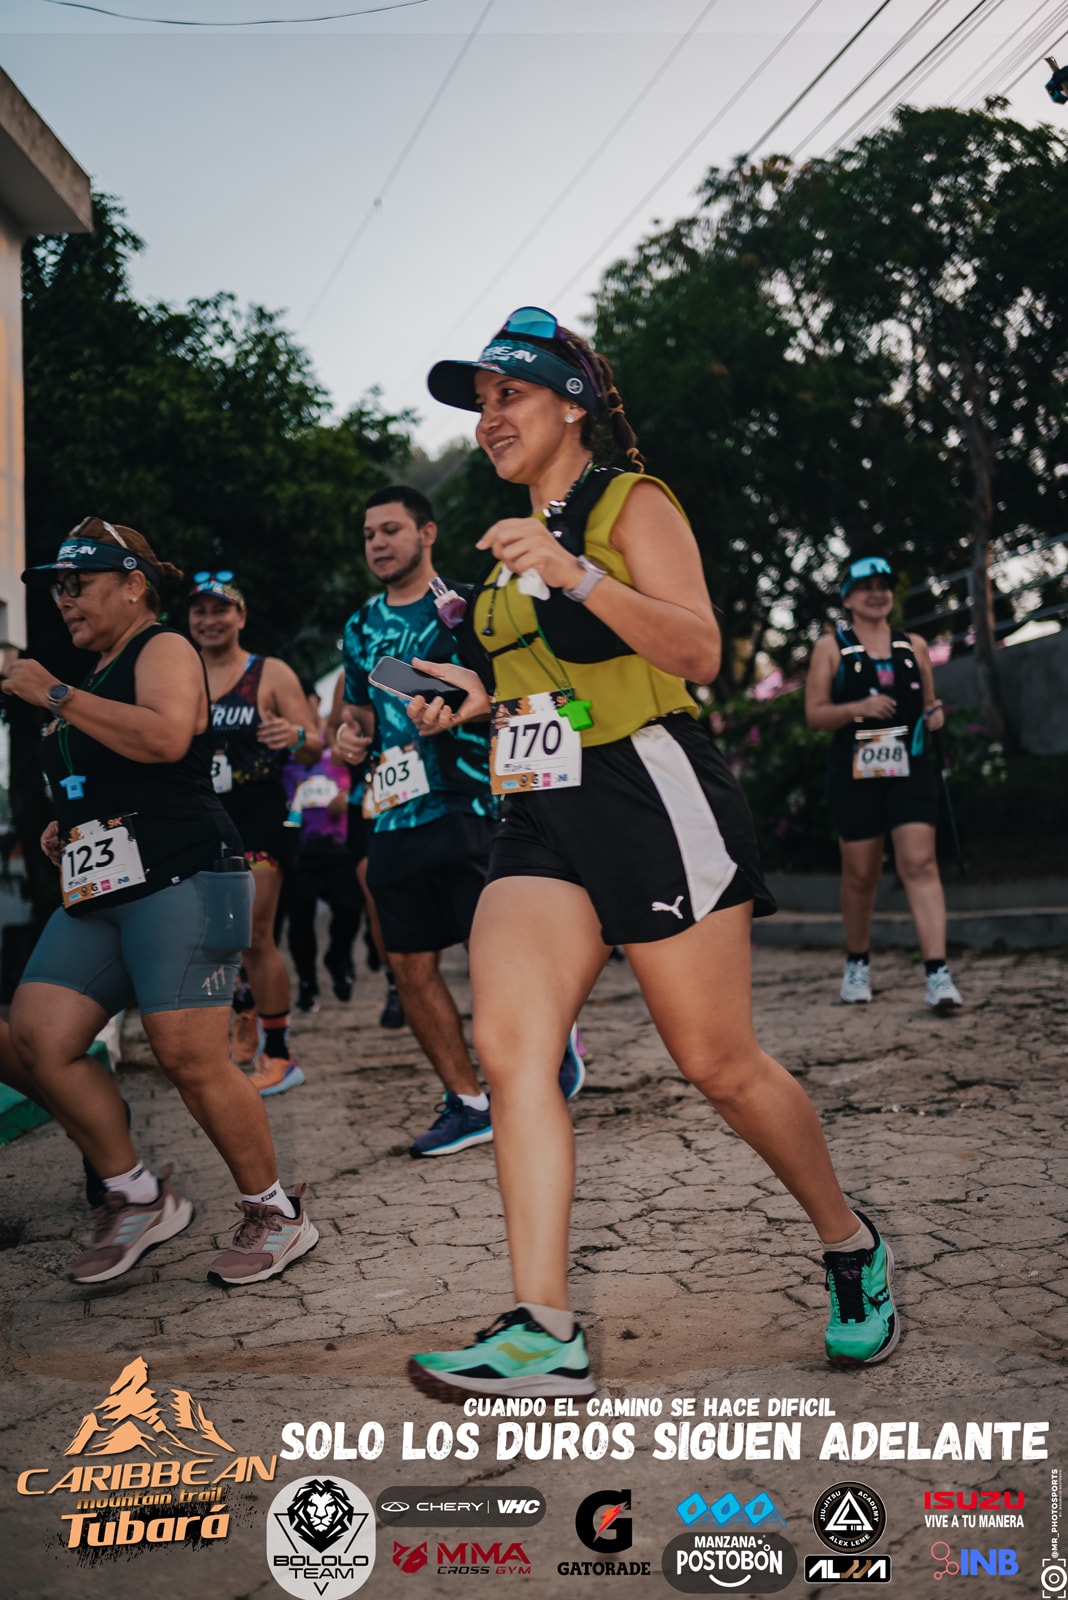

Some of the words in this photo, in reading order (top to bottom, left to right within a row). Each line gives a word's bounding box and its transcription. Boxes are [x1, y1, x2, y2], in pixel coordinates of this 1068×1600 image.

[508, 720, 562, 759] 170
[378, 760, 410, 790] 103
[68, 837, 115, 877] 123
